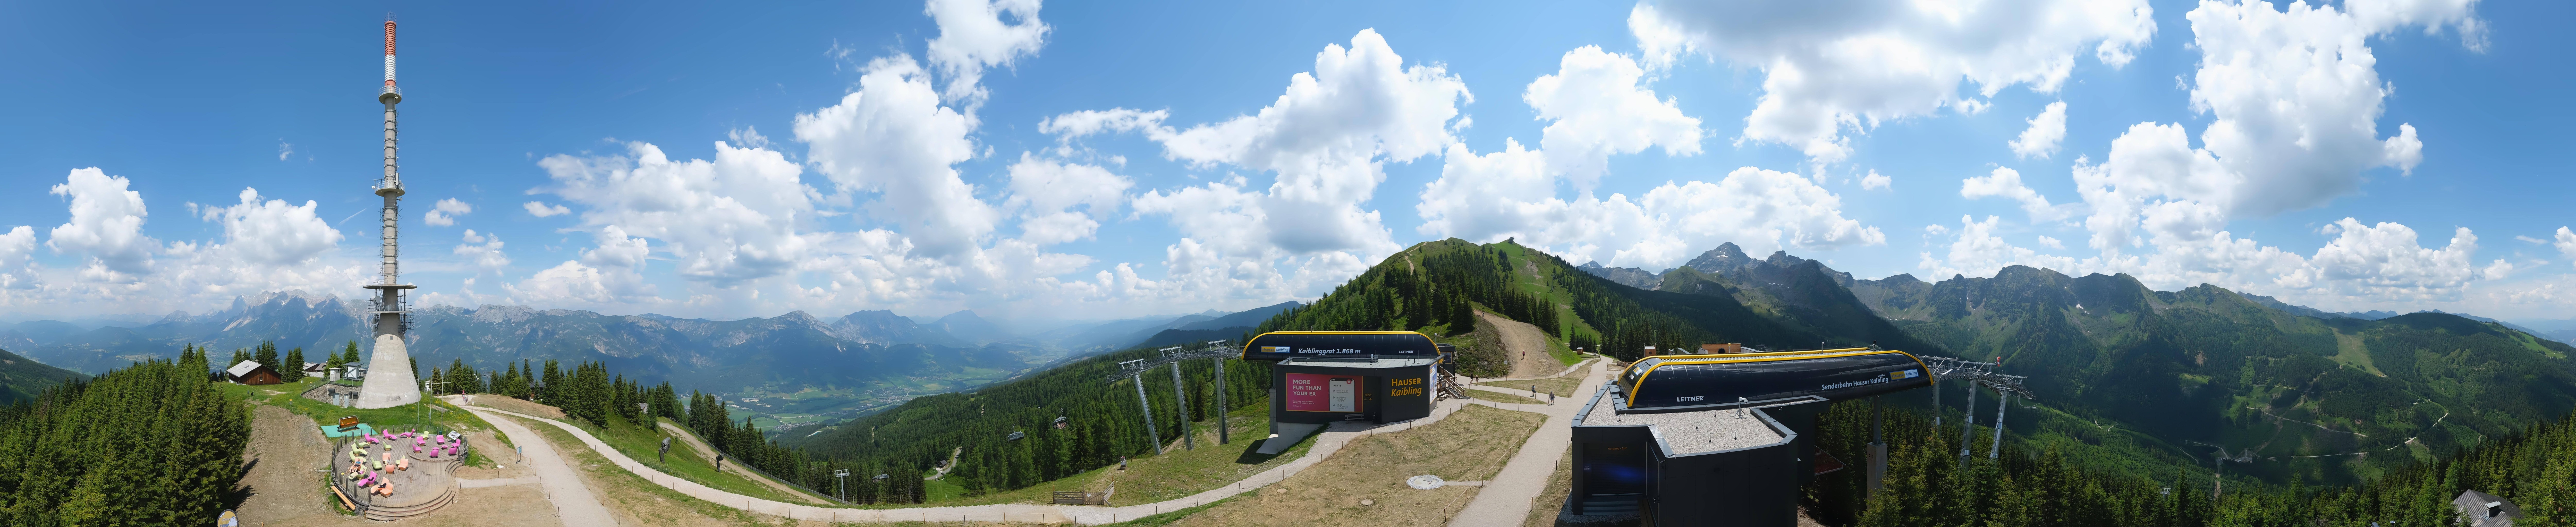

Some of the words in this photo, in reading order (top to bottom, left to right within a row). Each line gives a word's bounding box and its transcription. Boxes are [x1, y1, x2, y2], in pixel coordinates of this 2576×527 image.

[1392, 378, 1421, 387] HAUSER
[1822, 381, 1852, 390] Senderbahn
[1391, 387, 1422, 396] Kaibling
